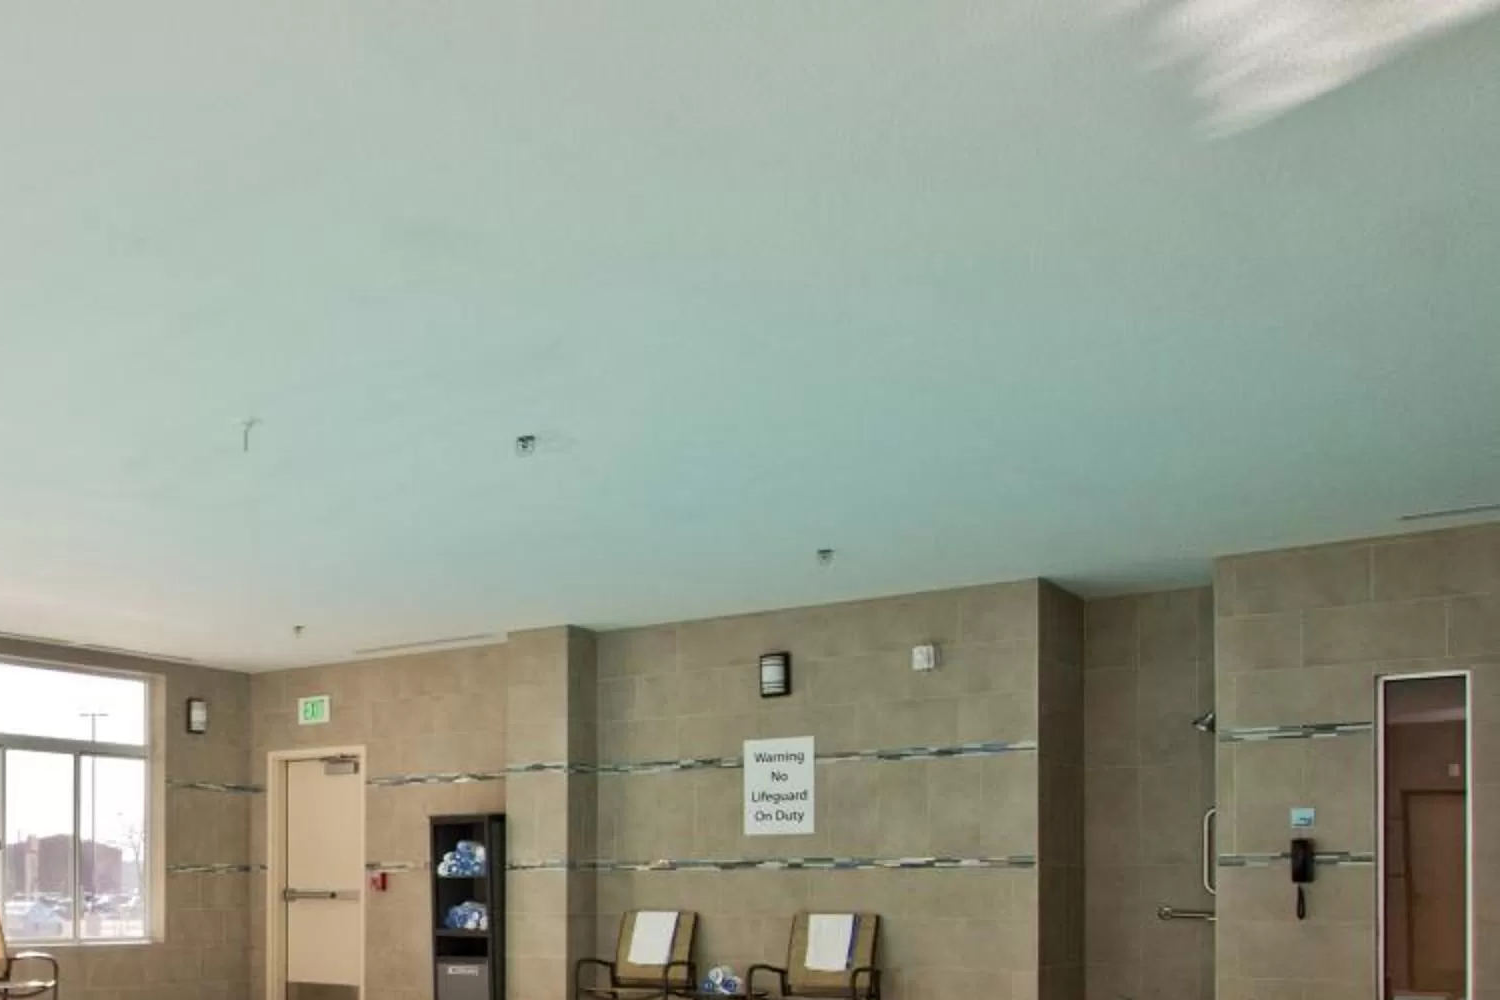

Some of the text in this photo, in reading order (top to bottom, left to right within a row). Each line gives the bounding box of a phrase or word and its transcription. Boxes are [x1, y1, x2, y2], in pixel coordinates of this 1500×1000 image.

[754, 751, 805, 764] Warning
[771, 771, 789, 781] No
[751, 789, 808, 804] Lifeguard
[755, 809, 805, 822] On Duty
